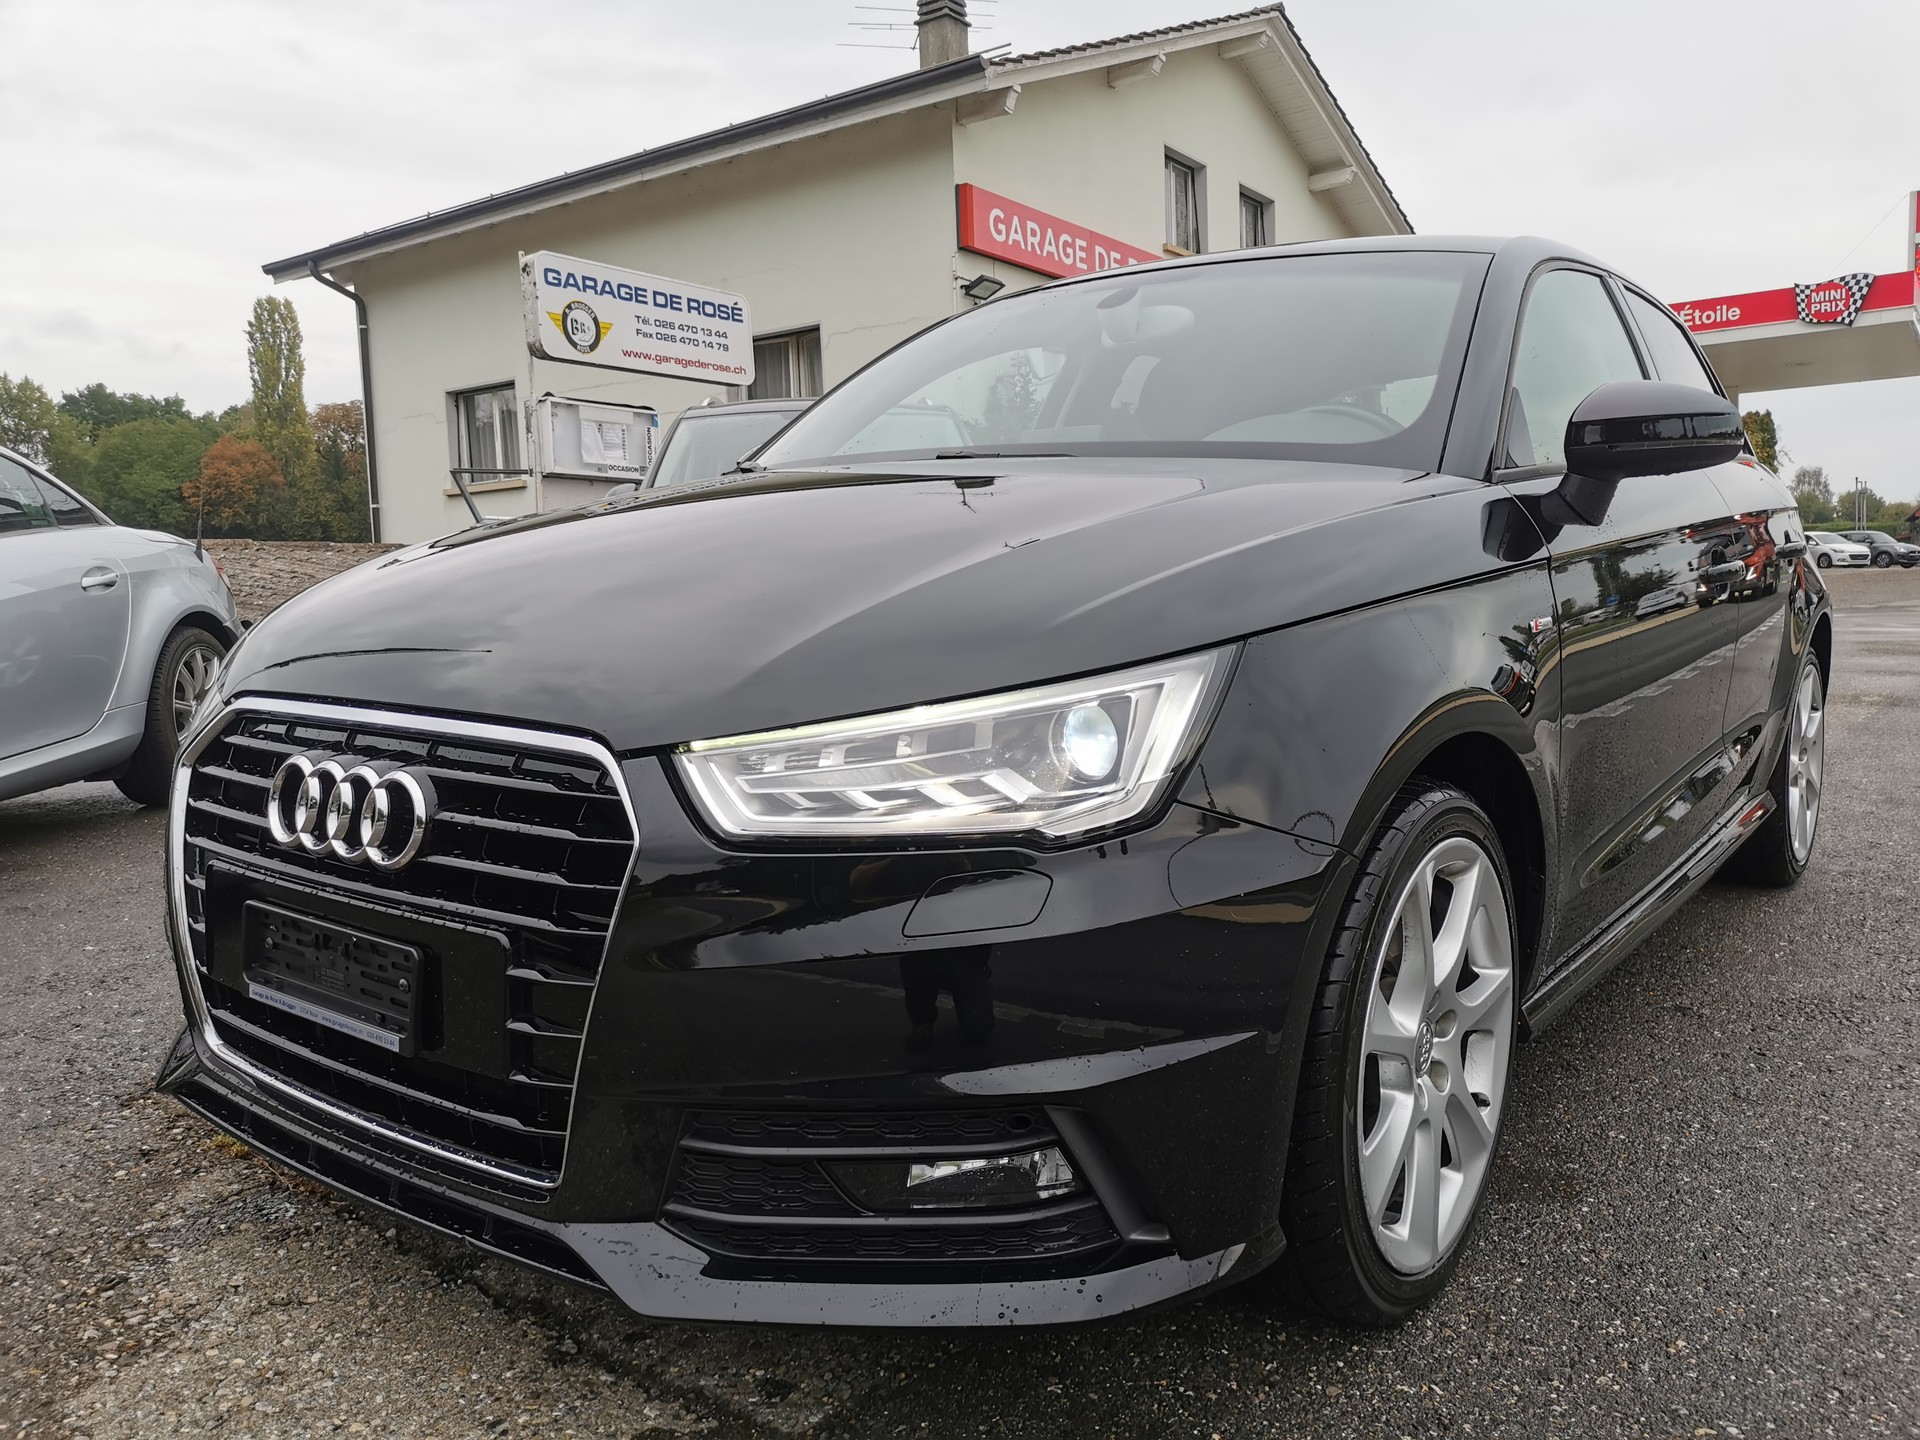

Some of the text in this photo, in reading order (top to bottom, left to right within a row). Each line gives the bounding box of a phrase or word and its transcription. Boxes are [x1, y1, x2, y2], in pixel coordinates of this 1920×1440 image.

[989, 208, 1088, 270] GARAGE
[543, 267, 744, 324] GARAGE DE ROSÉ
[1810, 288, 1846, 303] MINI
[1810, 300, 1846, 315] PRIX
[634, 315, 728, 339] Tél. 026 470 13 44
[635, 328, 654, 339] Fax
[655, 332, 677, 343] 026
[679, 336, 699, 347] 470
[701, 340, 714, 350] 14
[621, 348, 747, 376] www.garagederose.ch
[608, 464, 639, 473] OCCASION
